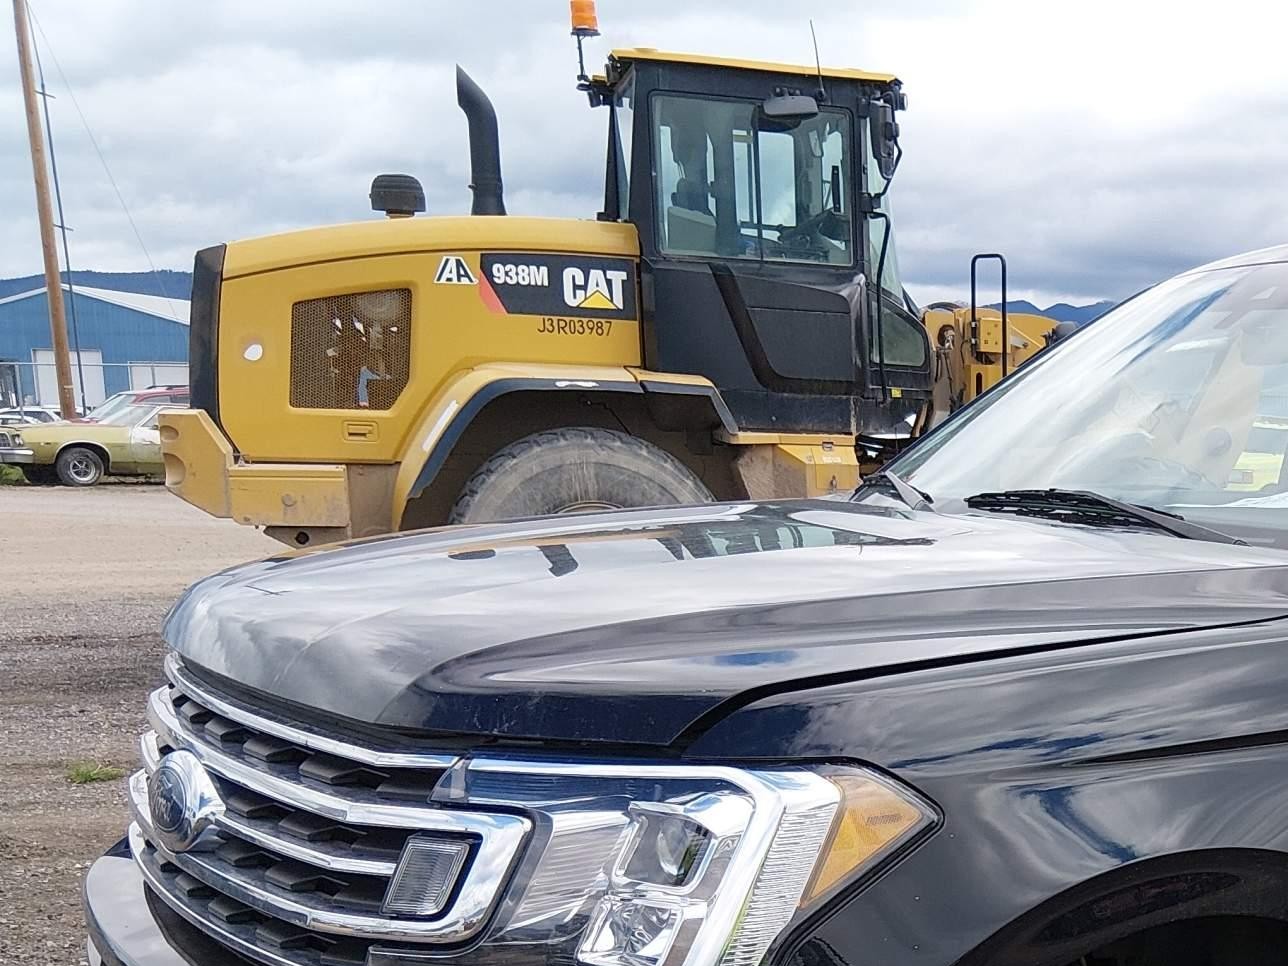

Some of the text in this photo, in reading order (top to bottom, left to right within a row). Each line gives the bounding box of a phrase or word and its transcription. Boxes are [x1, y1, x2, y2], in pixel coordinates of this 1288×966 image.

[491, 263, 549, 287] 938M
[562, 266, 627, 310] CAT
[537, 317, 613, 337] J3R03987
